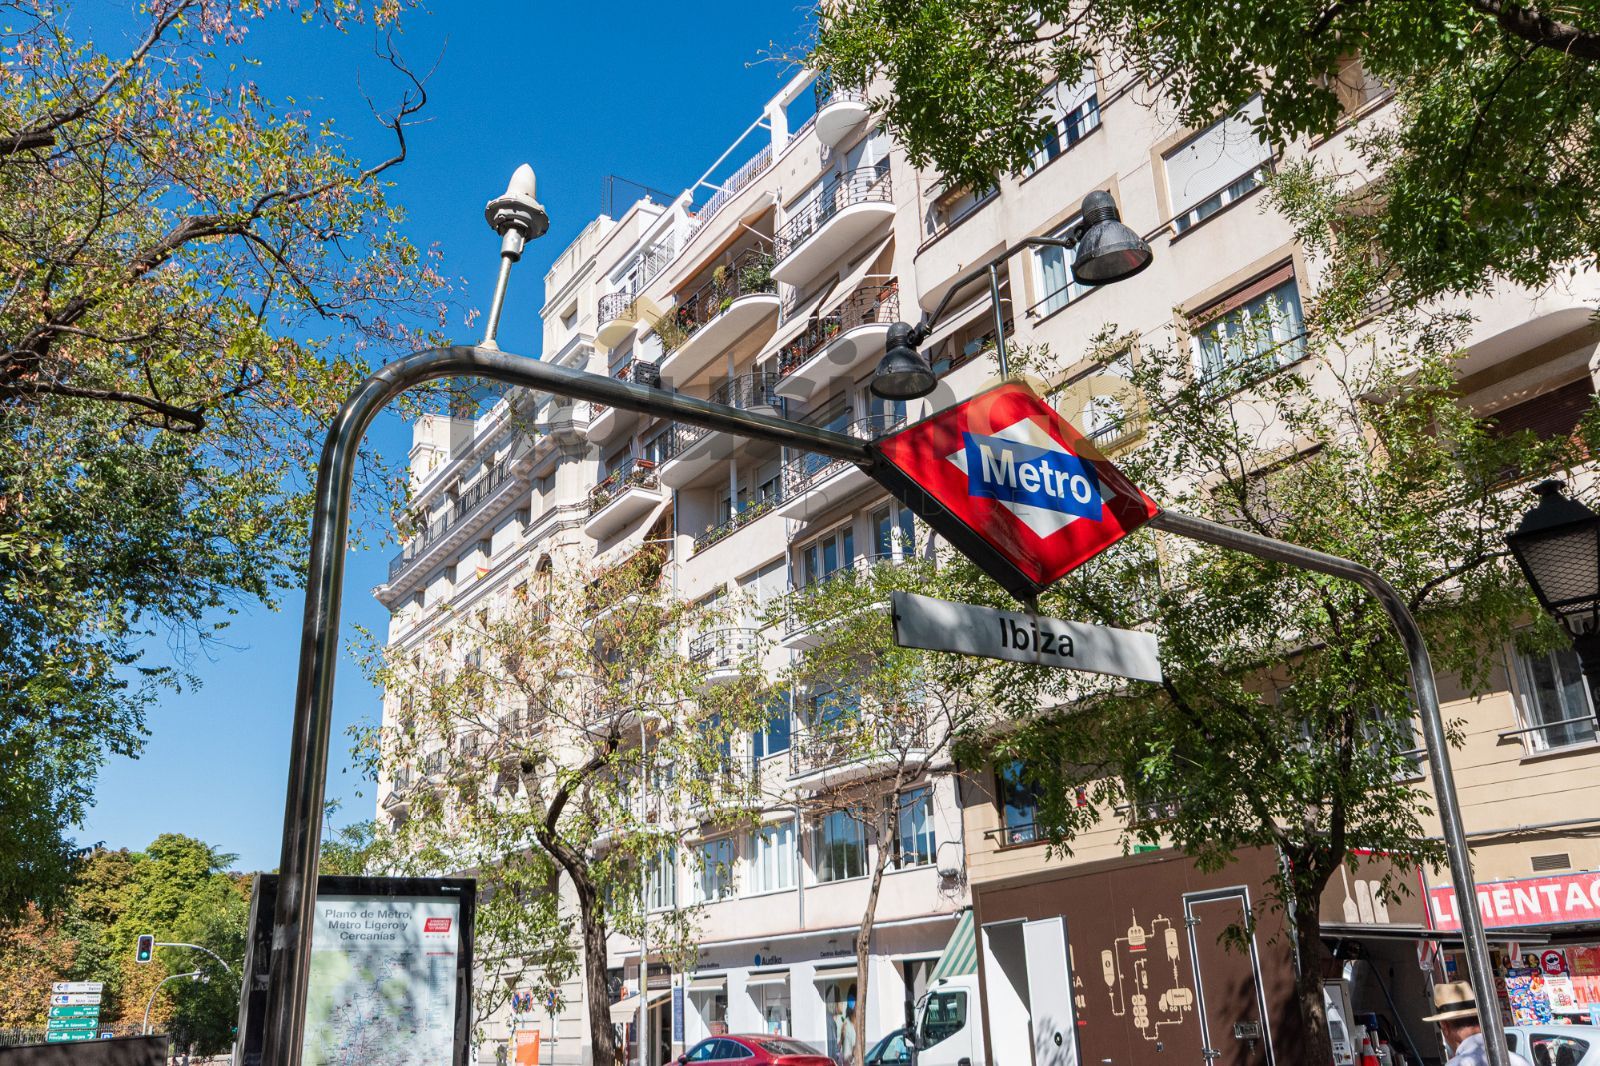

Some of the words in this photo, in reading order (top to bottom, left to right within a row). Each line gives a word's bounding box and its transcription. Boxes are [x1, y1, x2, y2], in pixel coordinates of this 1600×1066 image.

[979, 444, 1093, 505] Metro
[1000, 616, 1076, 659] Ibiza
[325, 909, 357, 919] Plano
[360, 910, 375, 919] de
[378, 910, 413, 921] Metro,
[328, 920, 362, 930] Metro
[401, 922, 409, 932] y
[340, 931, 396, 941] Cercanías
